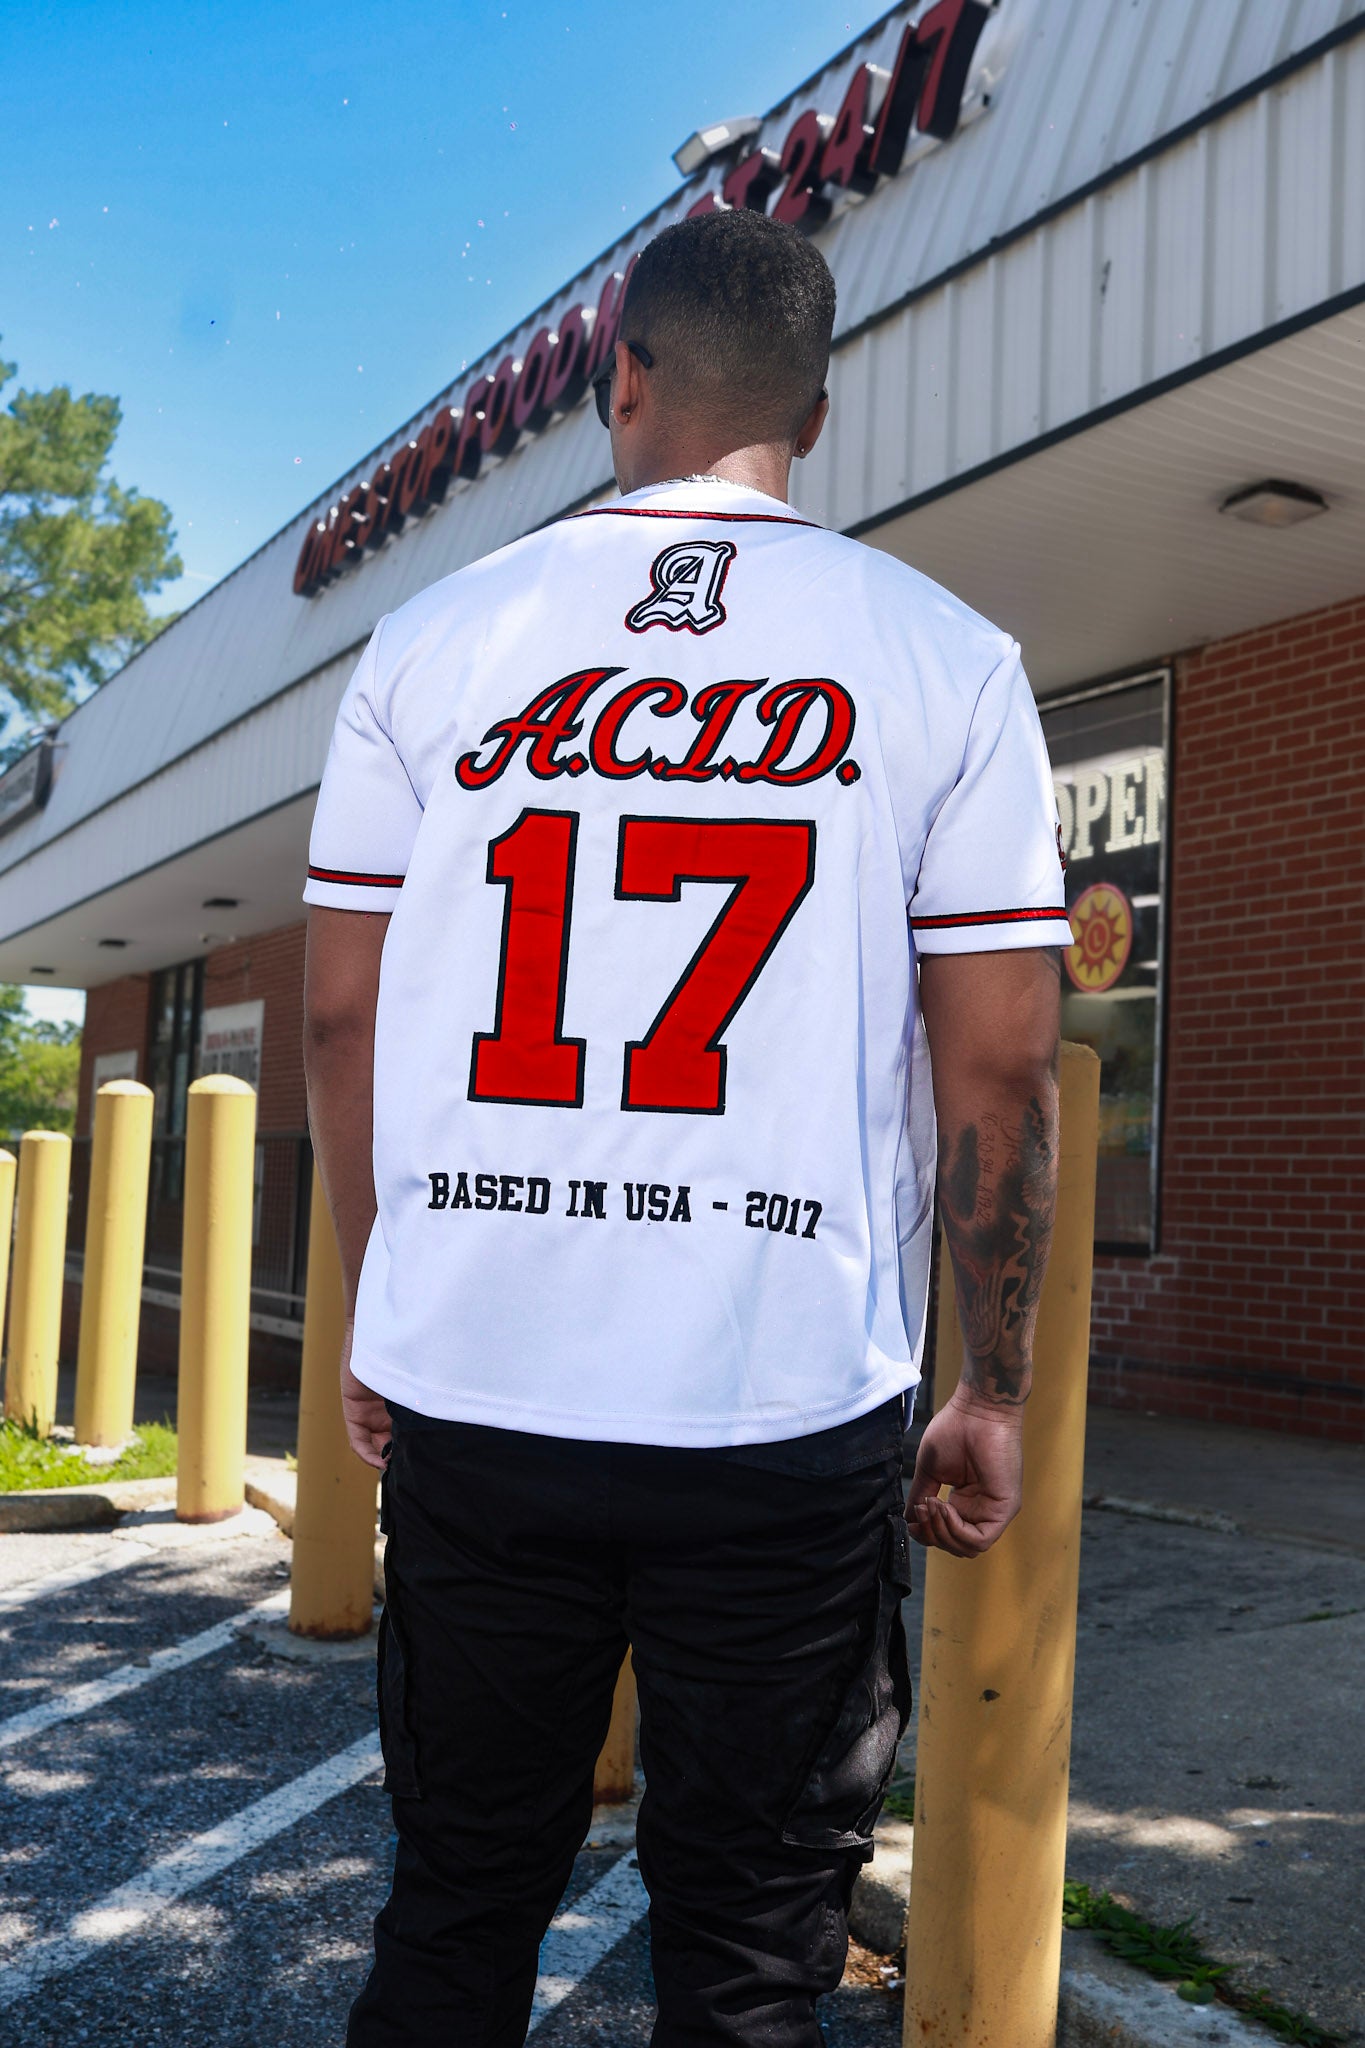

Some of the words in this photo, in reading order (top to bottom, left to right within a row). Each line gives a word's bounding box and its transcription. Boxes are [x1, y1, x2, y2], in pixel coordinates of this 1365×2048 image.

[356, 404, 456, 552] STOP
[452, 303, 592, 480] FOOD
[625, 541, 737, 635] A
[455, 667, 861, 791] A.C.I.D.
[467, 808, 817, 1115] 17
[428, 1172, 550, 1215] BASED
[566, 1180, 608, 1219] IN
[623, 1183, 692, 1223] USA
[745, 1191, 823, 1239] 2017
